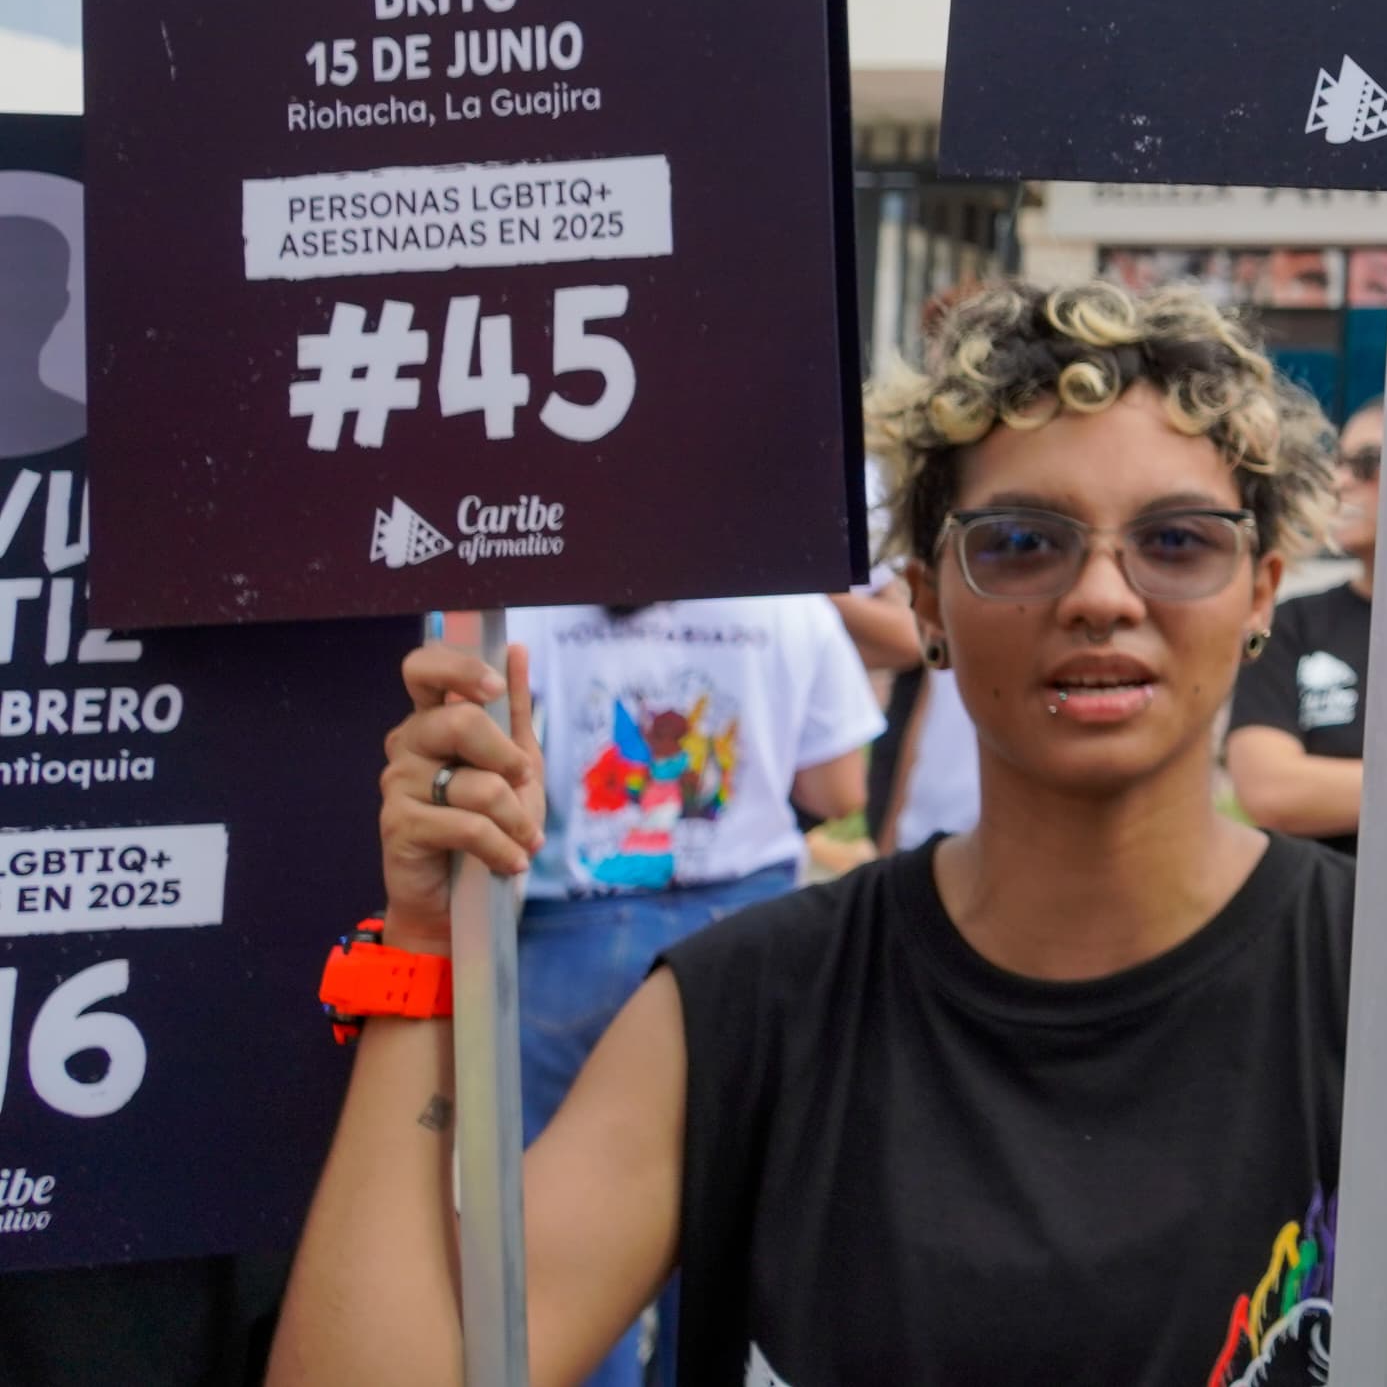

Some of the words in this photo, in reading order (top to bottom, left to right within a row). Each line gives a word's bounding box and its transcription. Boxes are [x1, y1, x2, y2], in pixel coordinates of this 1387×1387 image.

[305, 38, 358, 86] 15
[372, 34, 431, 82] DE
[446, 21, 583, 78] JUNIO
[287, 95, 436, 131] Riohacha,
[445, 92, 482, 121] La
[490, 82, 601, 120] Guajira
[288, 187, 460, 223] PERSONAS
[472, 178, 611, 212] LGBTIQ+
[279, 220, 487, 259] ASESINADAS
[499, 217, 540, 245] EN
[553, 211, 624, 241] 2025
[288, 284, 636, 451] #45
[456, 494, 565, 537] Caribe
[457, 530, 565, 566] afirmativo
[0, 845, 171, 878] GBTIQ+
[17, 885, 72, 913] EN
[88, 879, 181, 909] 2025
[0, 1207, 52, 1233] tivo
